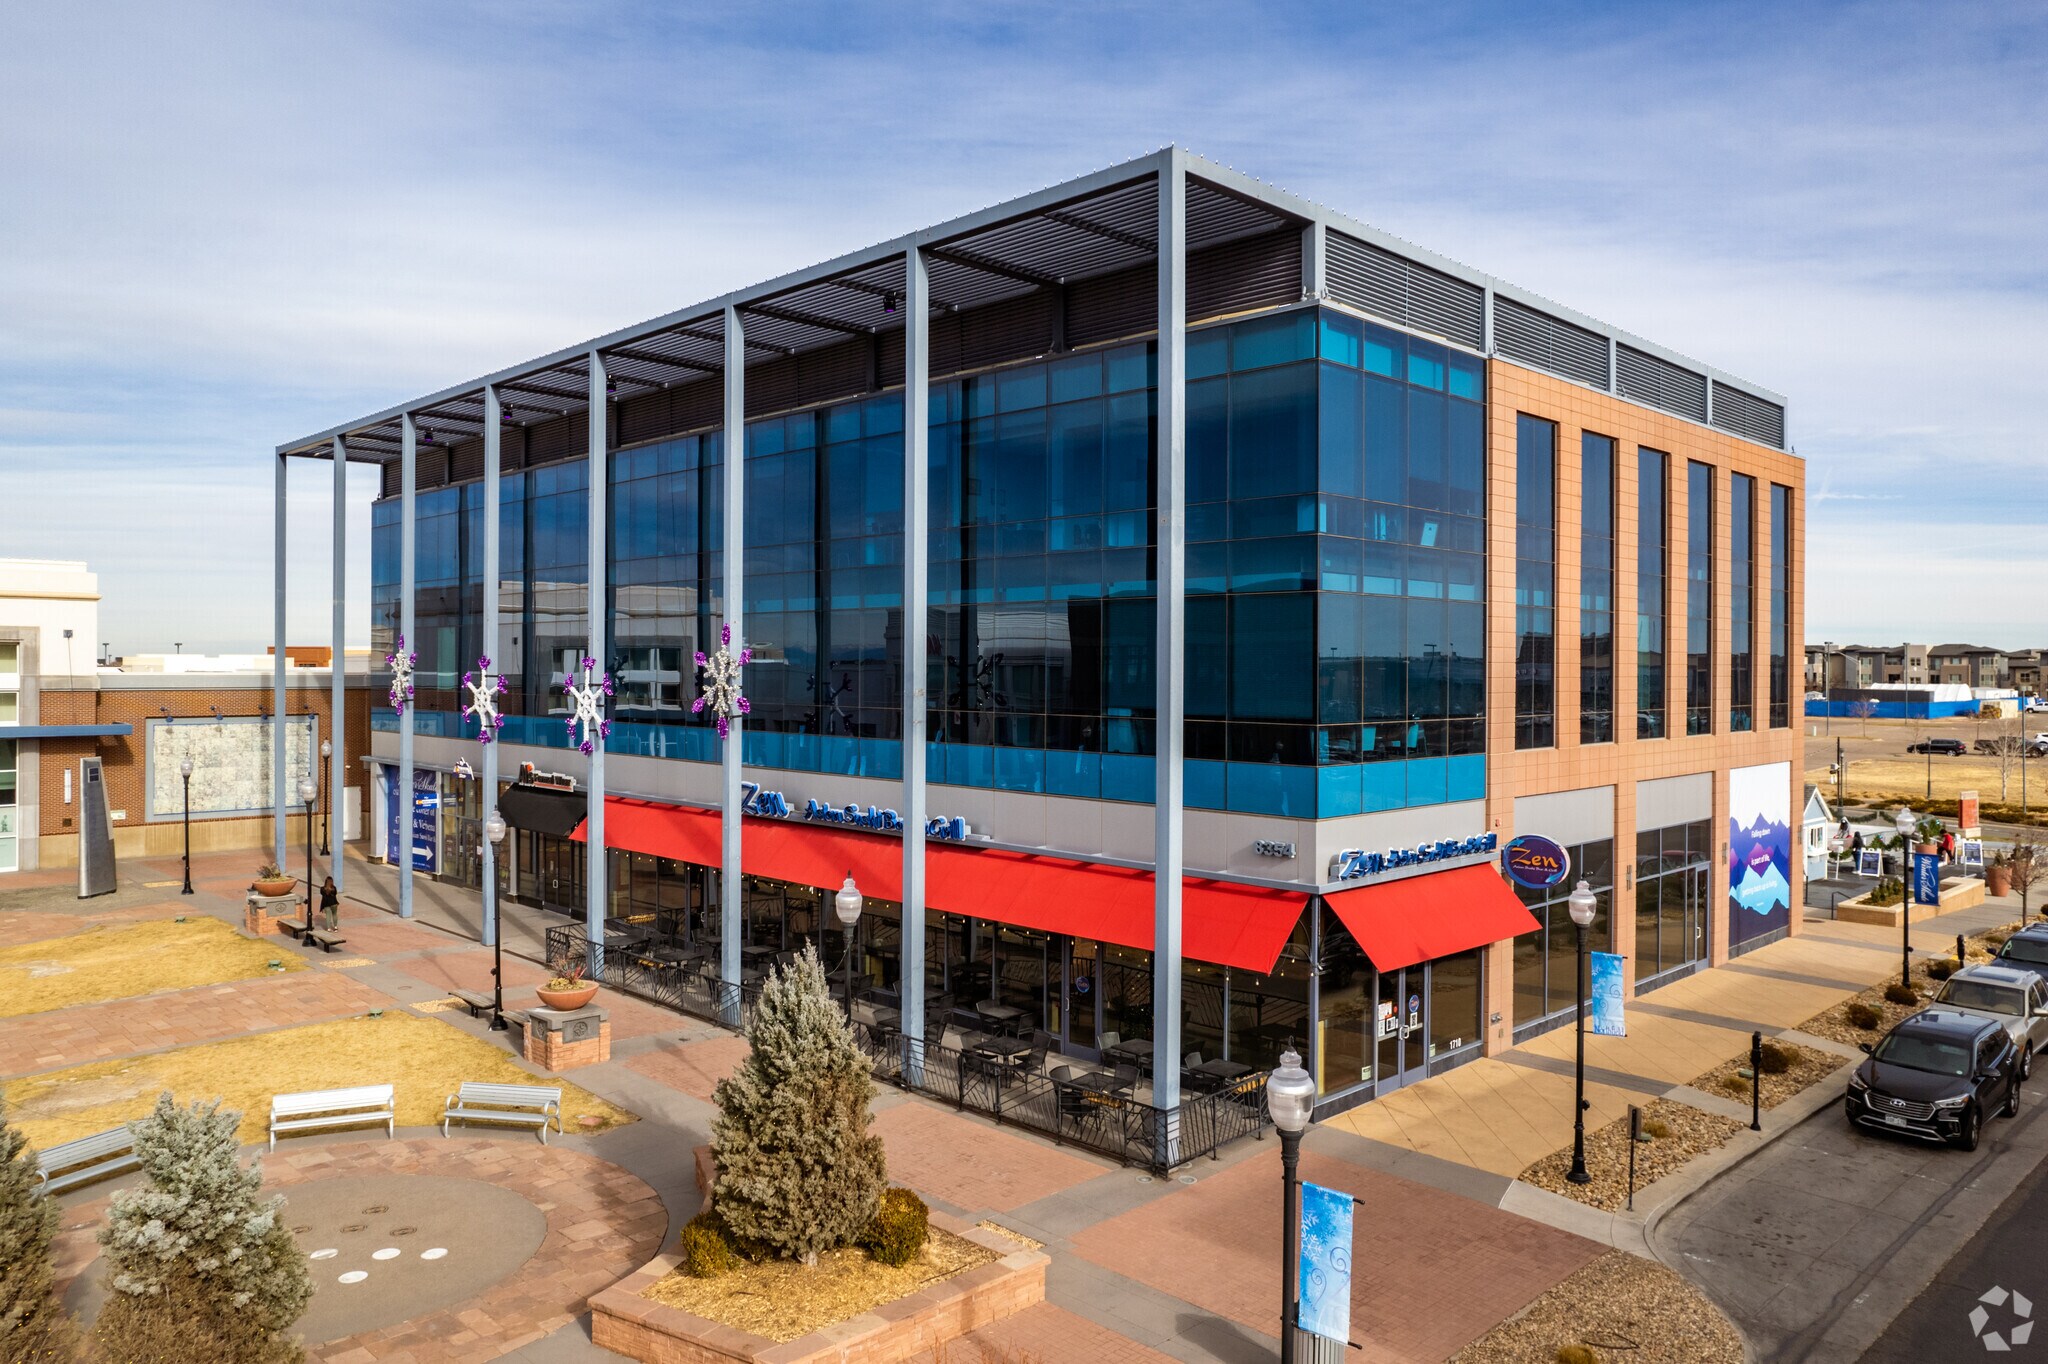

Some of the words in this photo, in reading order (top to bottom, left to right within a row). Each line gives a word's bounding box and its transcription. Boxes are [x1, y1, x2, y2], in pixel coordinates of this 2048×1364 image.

[741, 781, 789, 818] Zen
[881, 808, 903, 831] Ba
[1253, 839, 1297, 859] 8354
[1511, 847, 1559, 868] Zen
[1449, 1038, 1462, 1050] 1710
